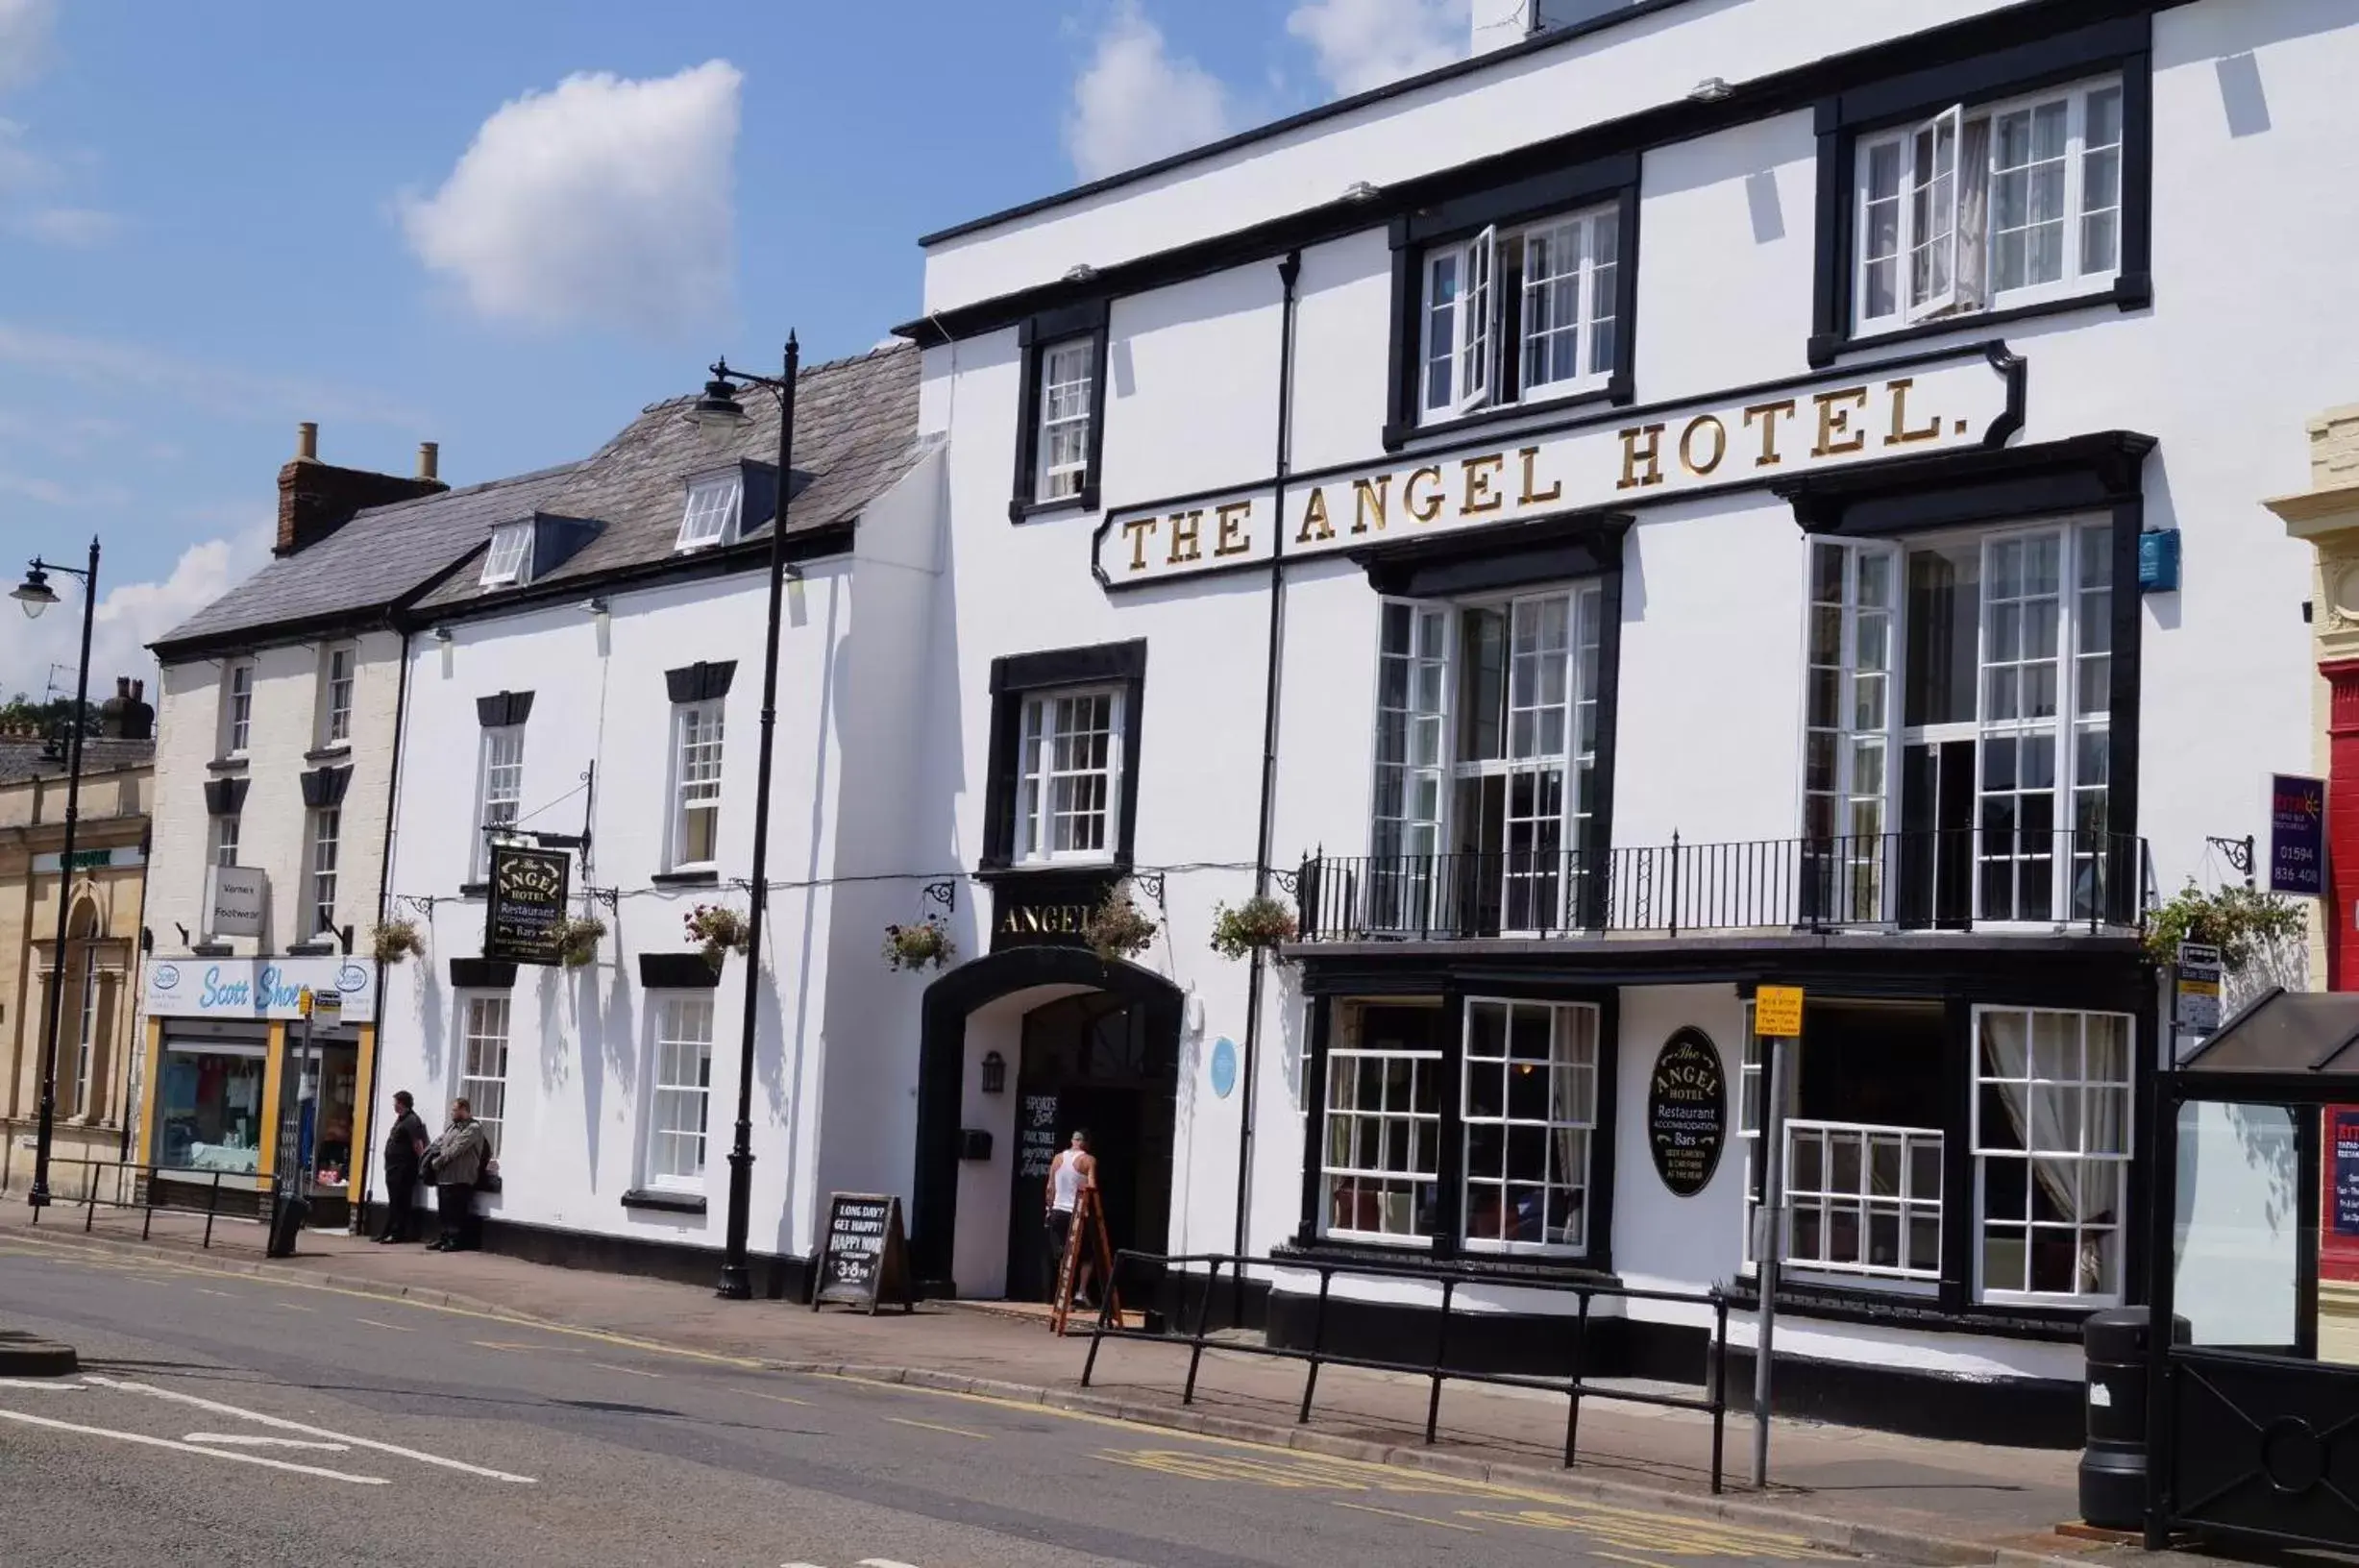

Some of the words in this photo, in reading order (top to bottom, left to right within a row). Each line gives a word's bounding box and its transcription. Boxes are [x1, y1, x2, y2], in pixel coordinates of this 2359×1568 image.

[1120, 499, 1252, 571] THE
[1295, 446, 1562, 545] ANGEL
[2279, 845, 2314, 862] 01594
[2273, 866, 2295, 881] 836
[2298, 868, 2319, 883] 408
[499, 871, 559, 898] ANGEL
[511, 889, 546, 901] HOTEL
[214, 906, 260, 919] Footwear
[500, 902, 556, 919] Restaurant
[199, 965, 249, 1009] Scott
[1677, 1042, 1701, 1059] The
[1656, 1065, 1718, 1096] ANGEL
[1669, 1089, 1705, 1101] HOTEL
[1658, 1105, 1715, 1119] Restaurant
[1654, 1120, 1719, 1132] ACCOMMODATION
[1674, 1131, 1697, 1147] Bars
[839, 1205, 862, 1217] LONG
[862, 1207, 885, 1219] DAY?
[834, 1219, 850, 1231] GET
[830, 1234, 862, 1252] HAPPY
